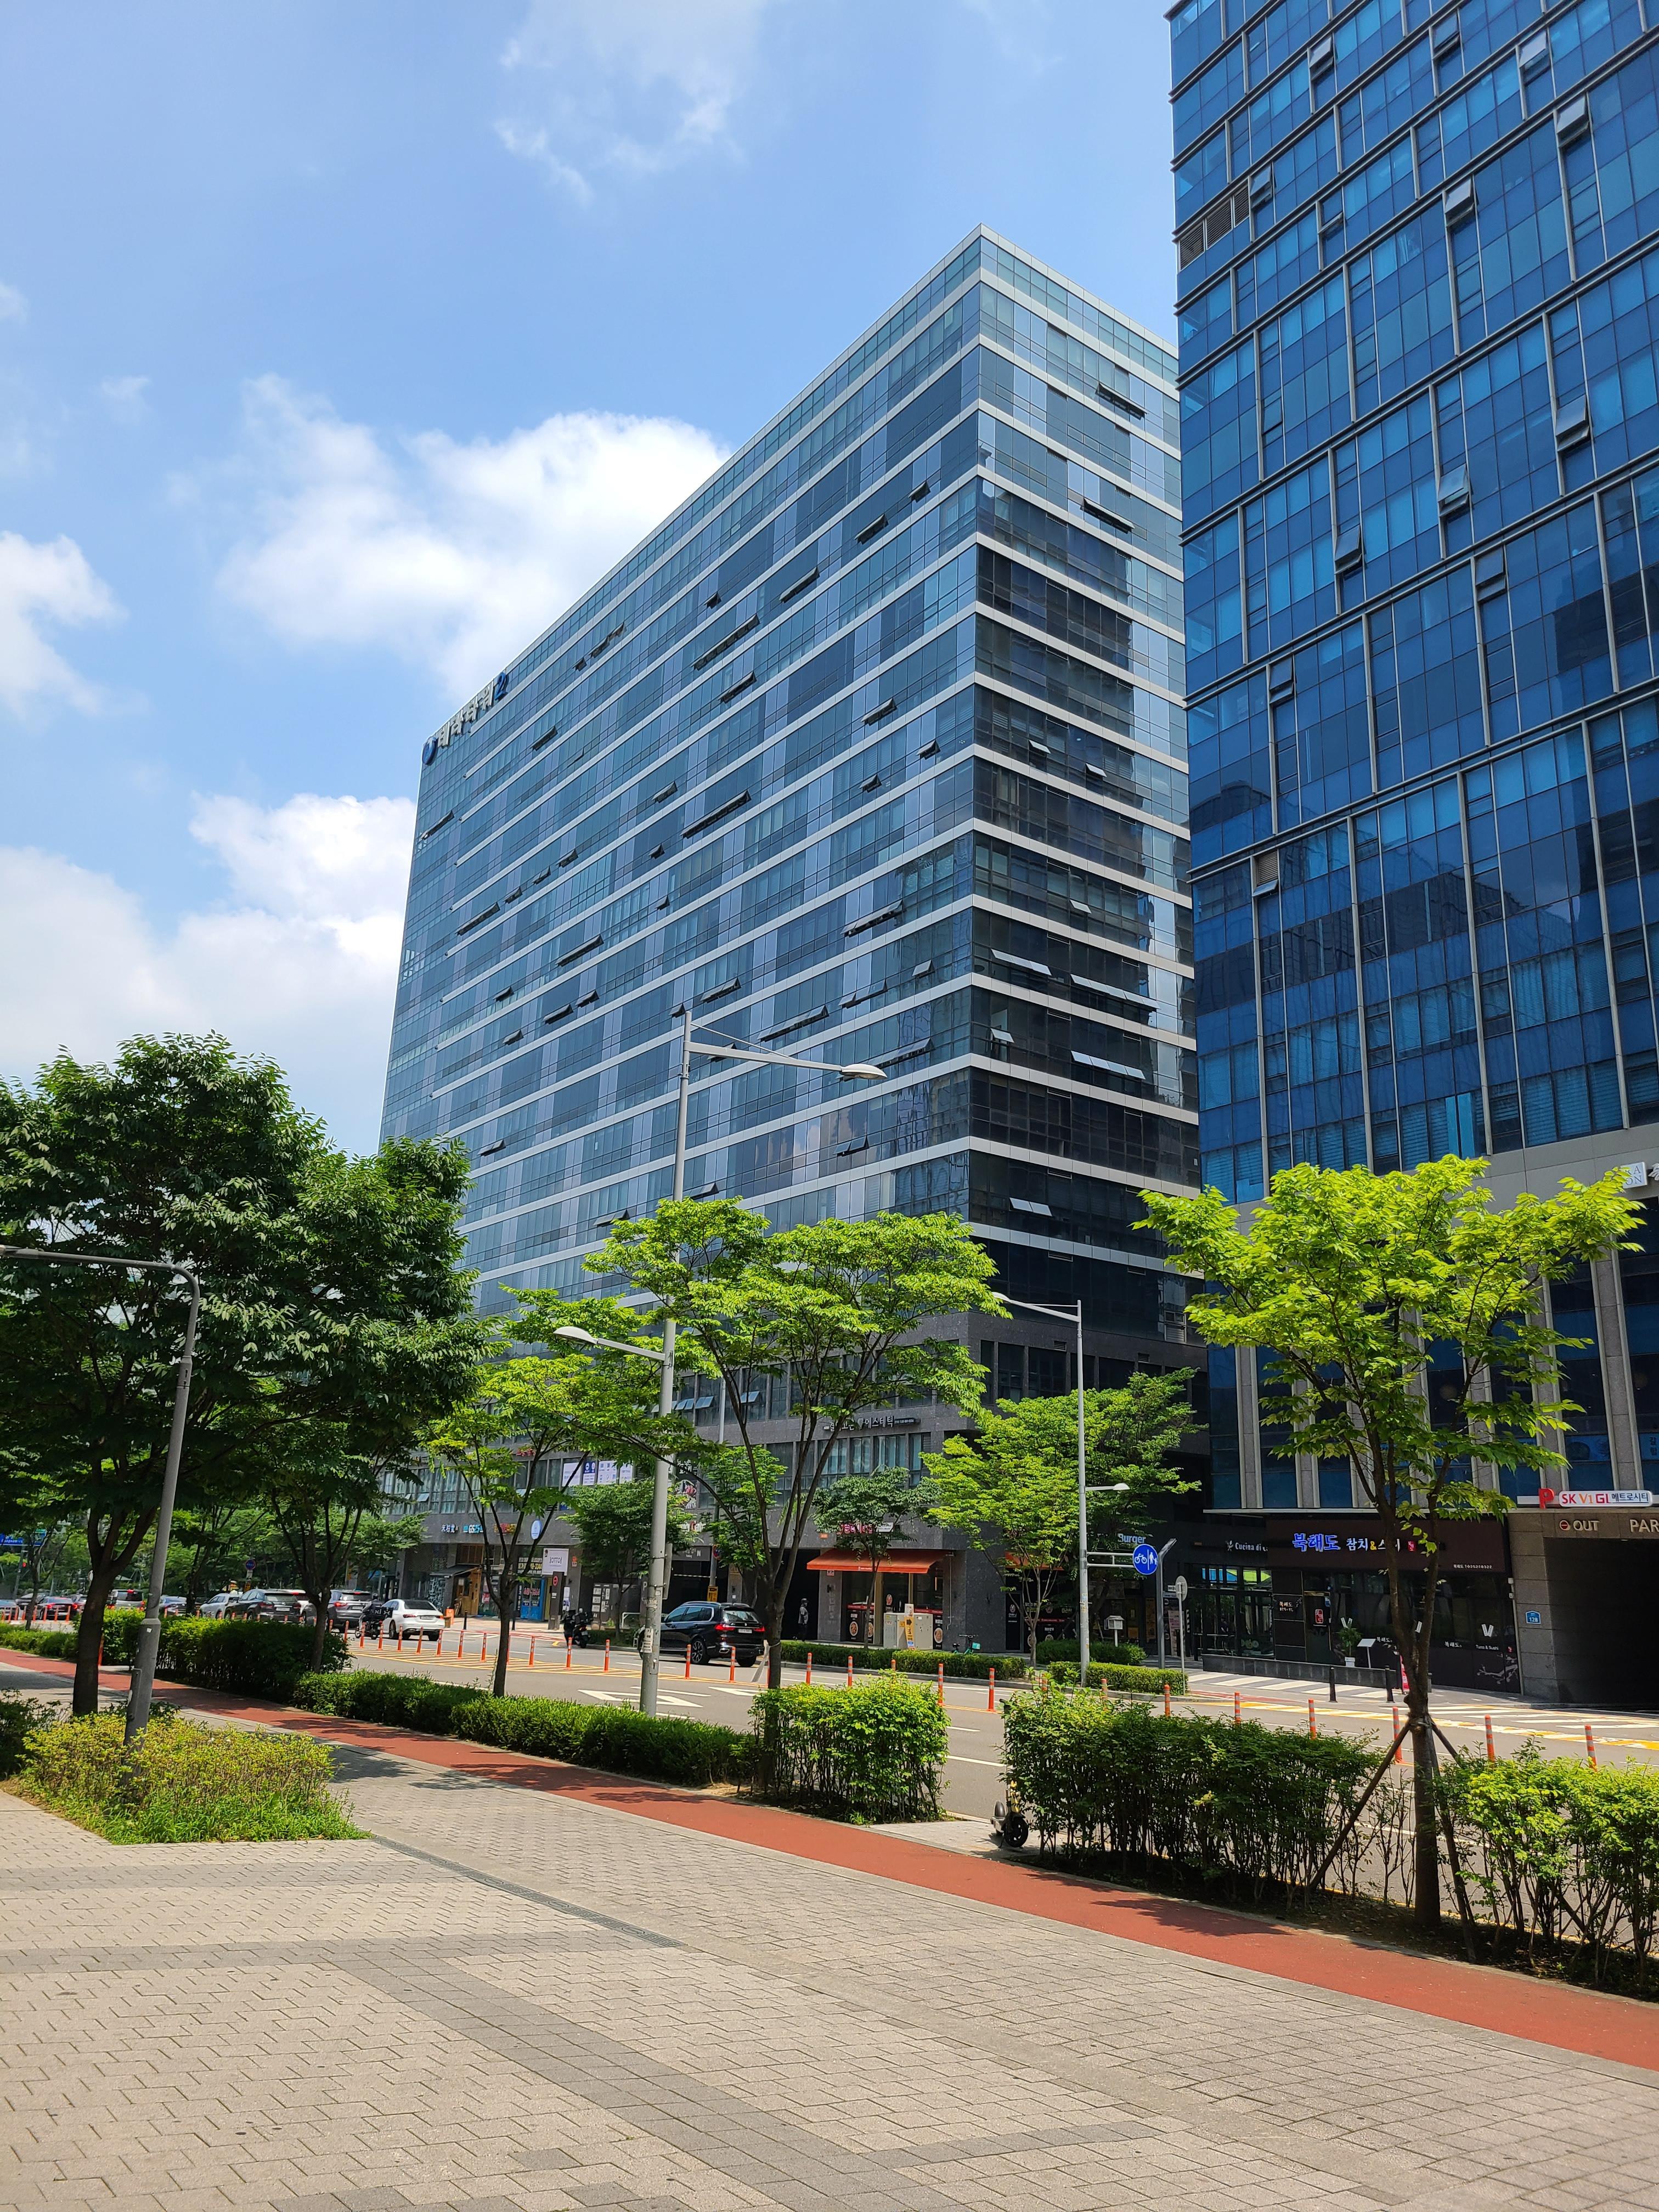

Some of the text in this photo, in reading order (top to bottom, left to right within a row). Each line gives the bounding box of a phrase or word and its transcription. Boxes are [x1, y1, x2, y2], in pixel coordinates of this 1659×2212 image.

[865, 1415, 894, 1428] 에스테틱
[1538, 1488, 1555, 1509] P
[1562, 1494, 1577, 1504] SK
[1579, 1494, 1593, 1503] V1
[1611, 1493, 1649, 1502] 메트로시티
[1573, 1520, 1599, 1531] OUT
[1629, 1519, 1659, 1532] PAR
[1118, 1533, 1146, 1544] Burger
[1293, 1533, 1341, 1552] 북해도
[1235, 1542, 1255, 1550] Cucina
